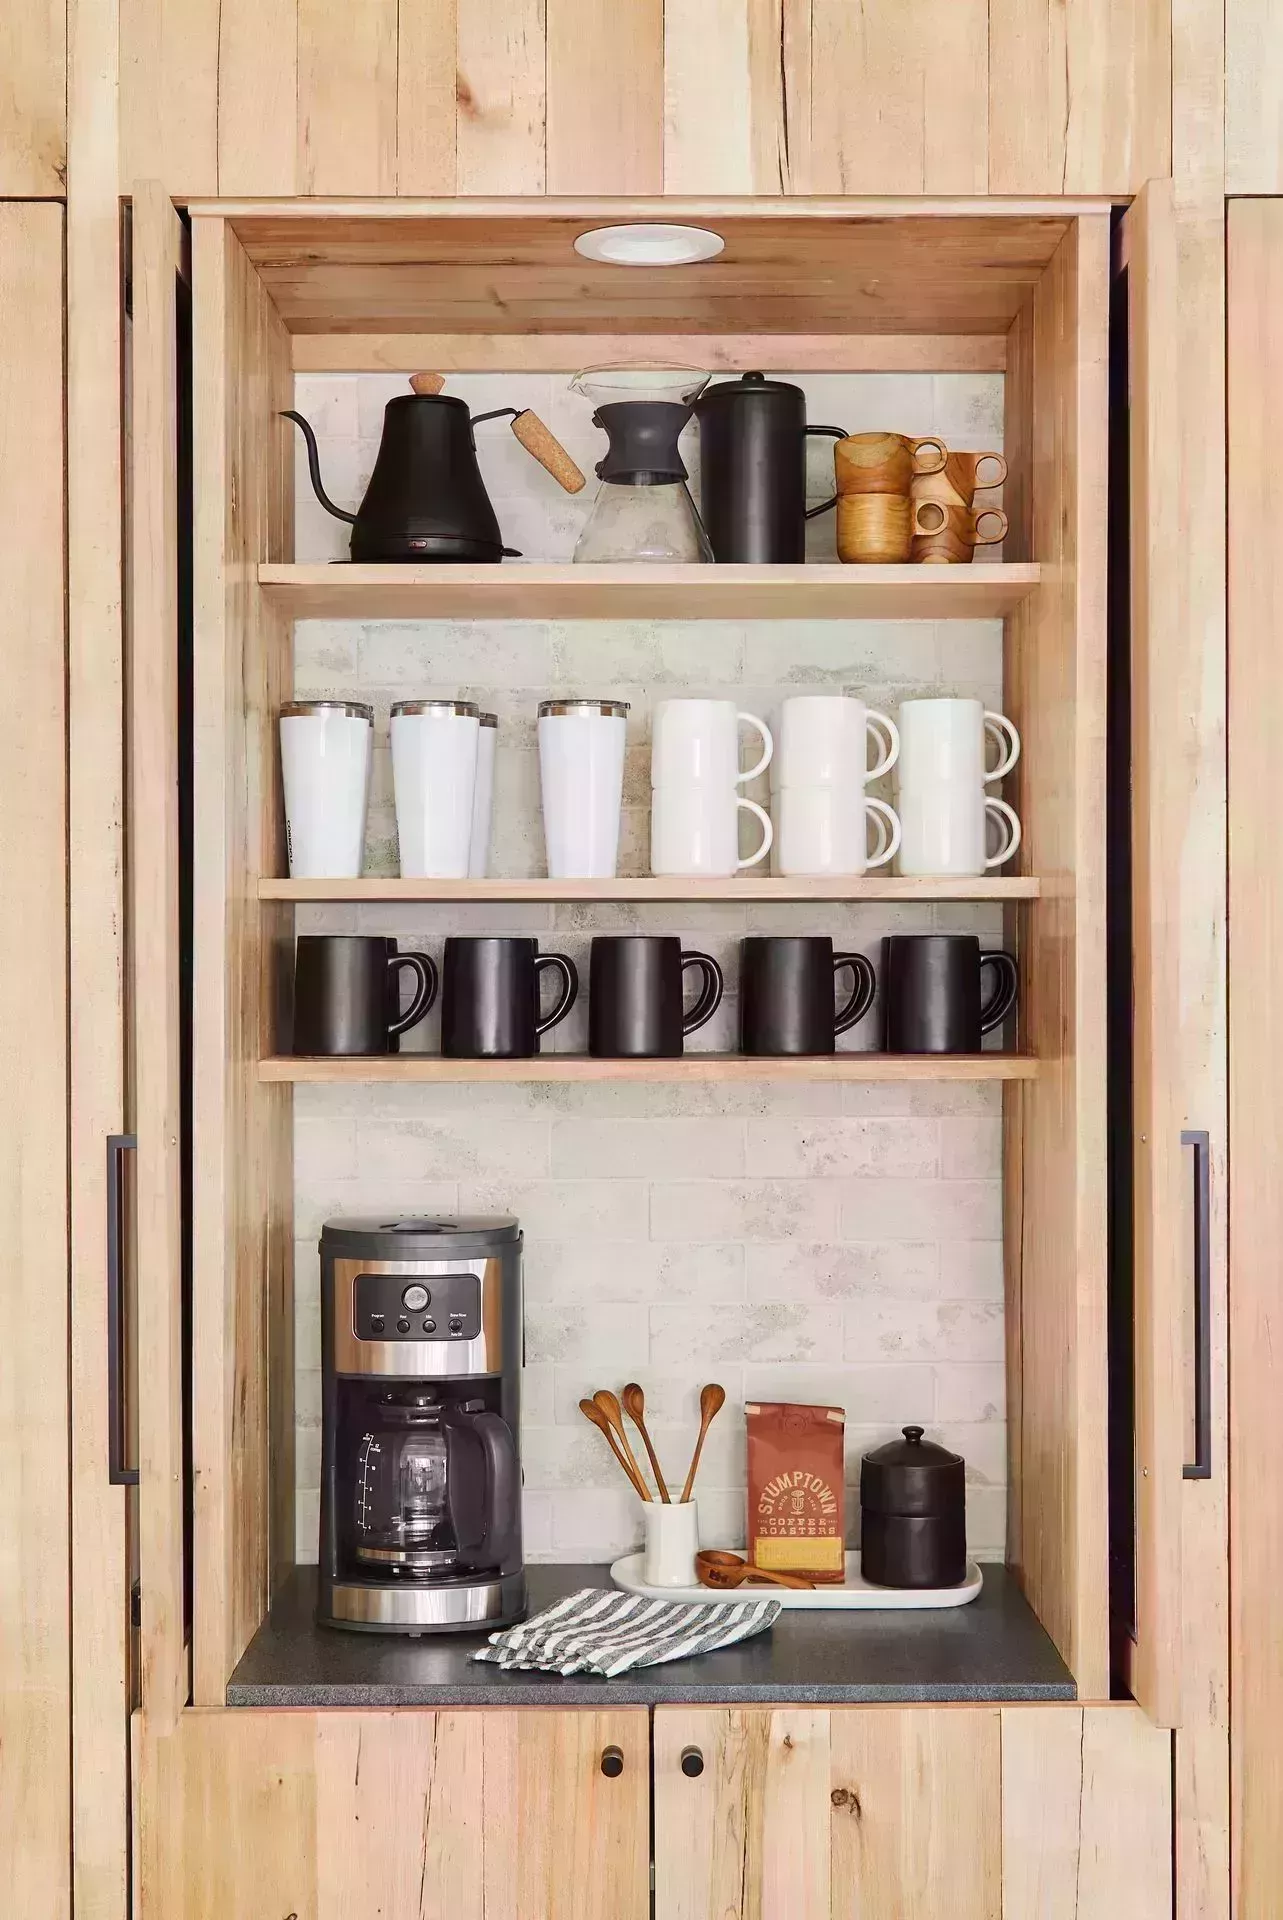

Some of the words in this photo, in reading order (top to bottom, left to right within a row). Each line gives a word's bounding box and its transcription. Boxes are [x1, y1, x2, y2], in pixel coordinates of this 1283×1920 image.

[758, 1471, 837, 1515] STUMPTOWN
[769, 1518, 827, 1526] COFFEE
[759, 1527, 836, 1535] ROASTERS
